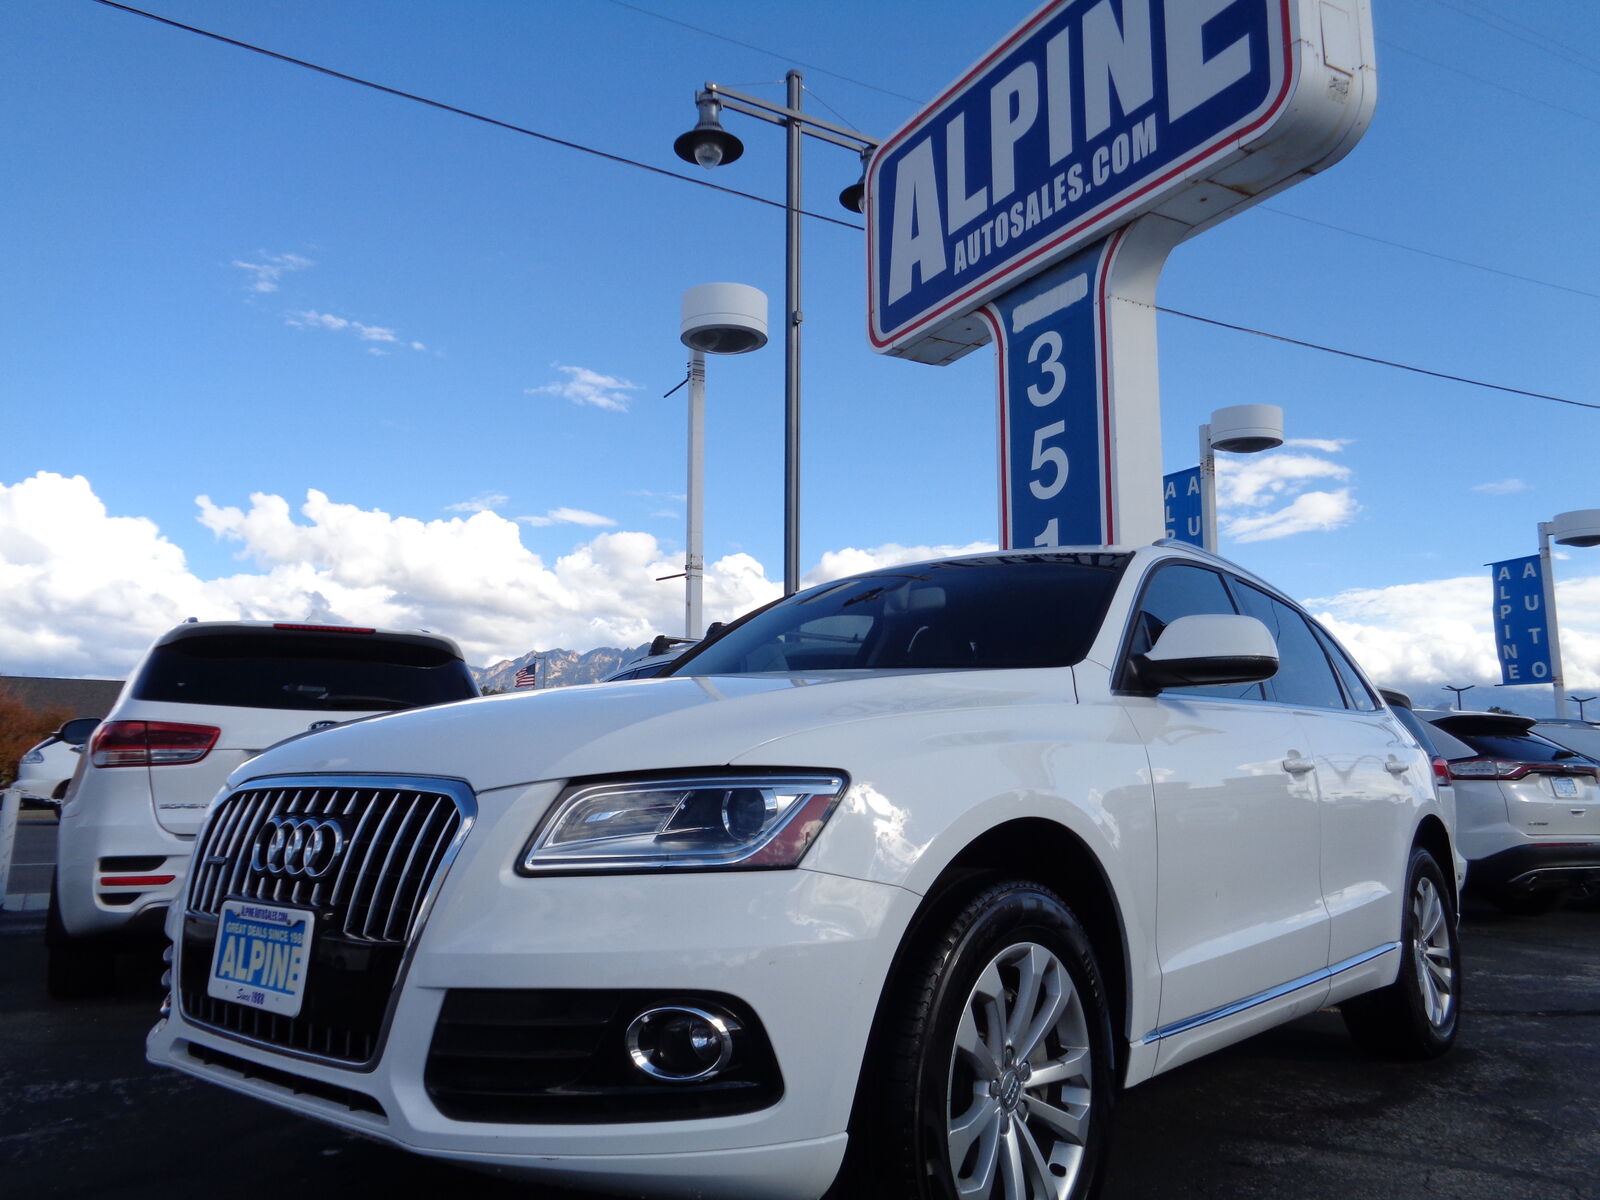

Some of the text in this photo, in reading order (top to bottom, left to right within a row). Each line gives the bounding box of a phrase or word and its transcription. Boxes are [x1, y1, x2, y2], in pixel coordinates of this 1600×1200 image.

[888, 0, 1252, 306] ALPINE
[954, 113, 1157, 275] AUTOSALES.COM
[1498, 567, 1520, 679] ALPINE
[1522, 562, 1547, 678] AUTO
[218, 935, 304, 991] ALPINE
[226, 922, 246, 934] GREAT
[247, 925, 267, 939] DEALS
[268, 928, 288, 942] SINCE
